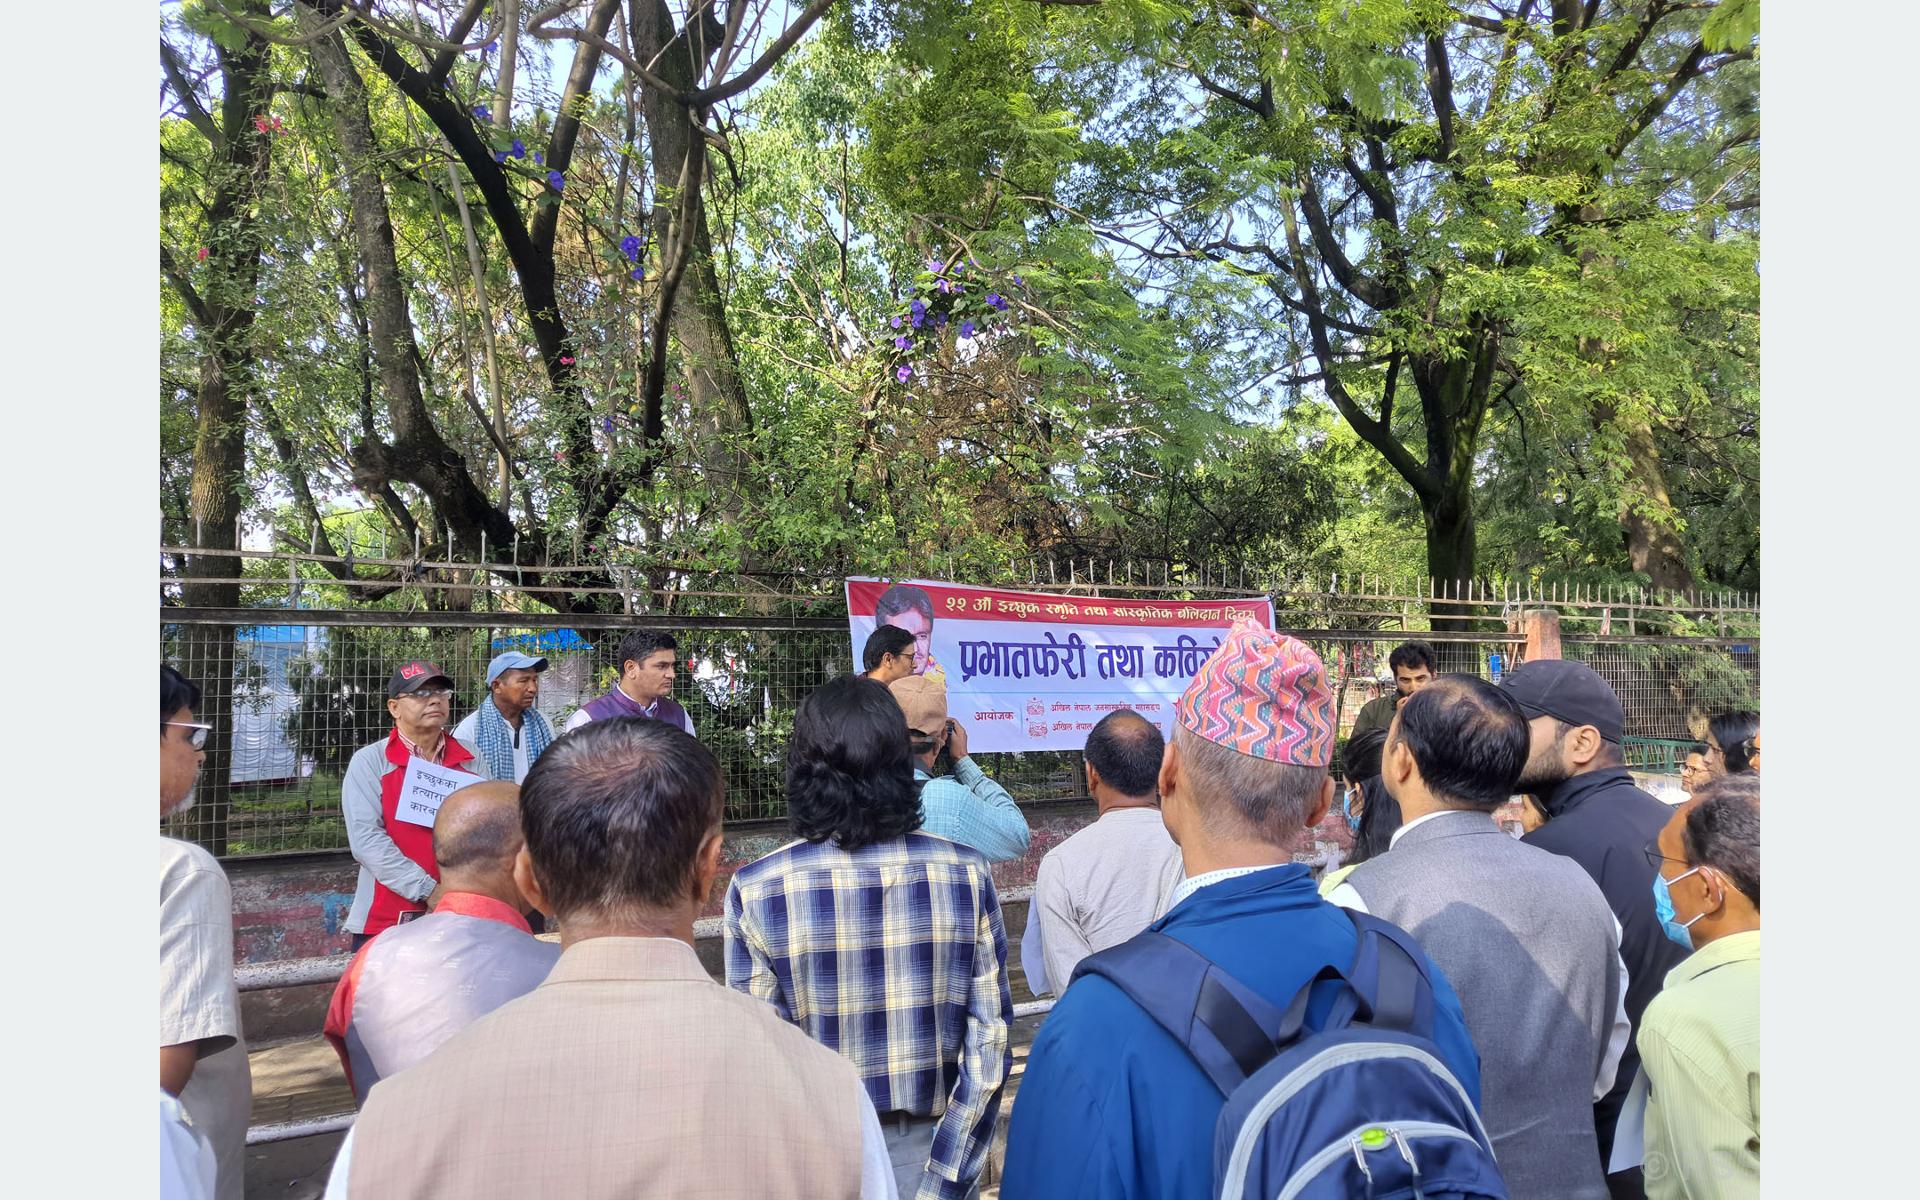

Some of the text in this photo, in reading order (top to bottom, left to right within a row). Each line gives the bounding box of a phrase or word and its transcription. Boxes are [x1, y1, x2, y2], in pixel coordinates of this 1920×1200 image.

[945, 596, 967, 612] २२
[1045, 602, 1079, 620] स्मृति
[1084, 605, 1108, 617] तथा
[1177, 606, 1221, 621] बलिदान
[958, 631, 1087, 683] प्रभातफेरी
[1095, 644, 1144, 680] तथा
[1051, 701, 1071, 712] अखिल
[974, 708, 1014, 721] आयोजक
[1053, 721, 1073, 731] अखिल
[412, 785, 446, 802] हत्यारा
